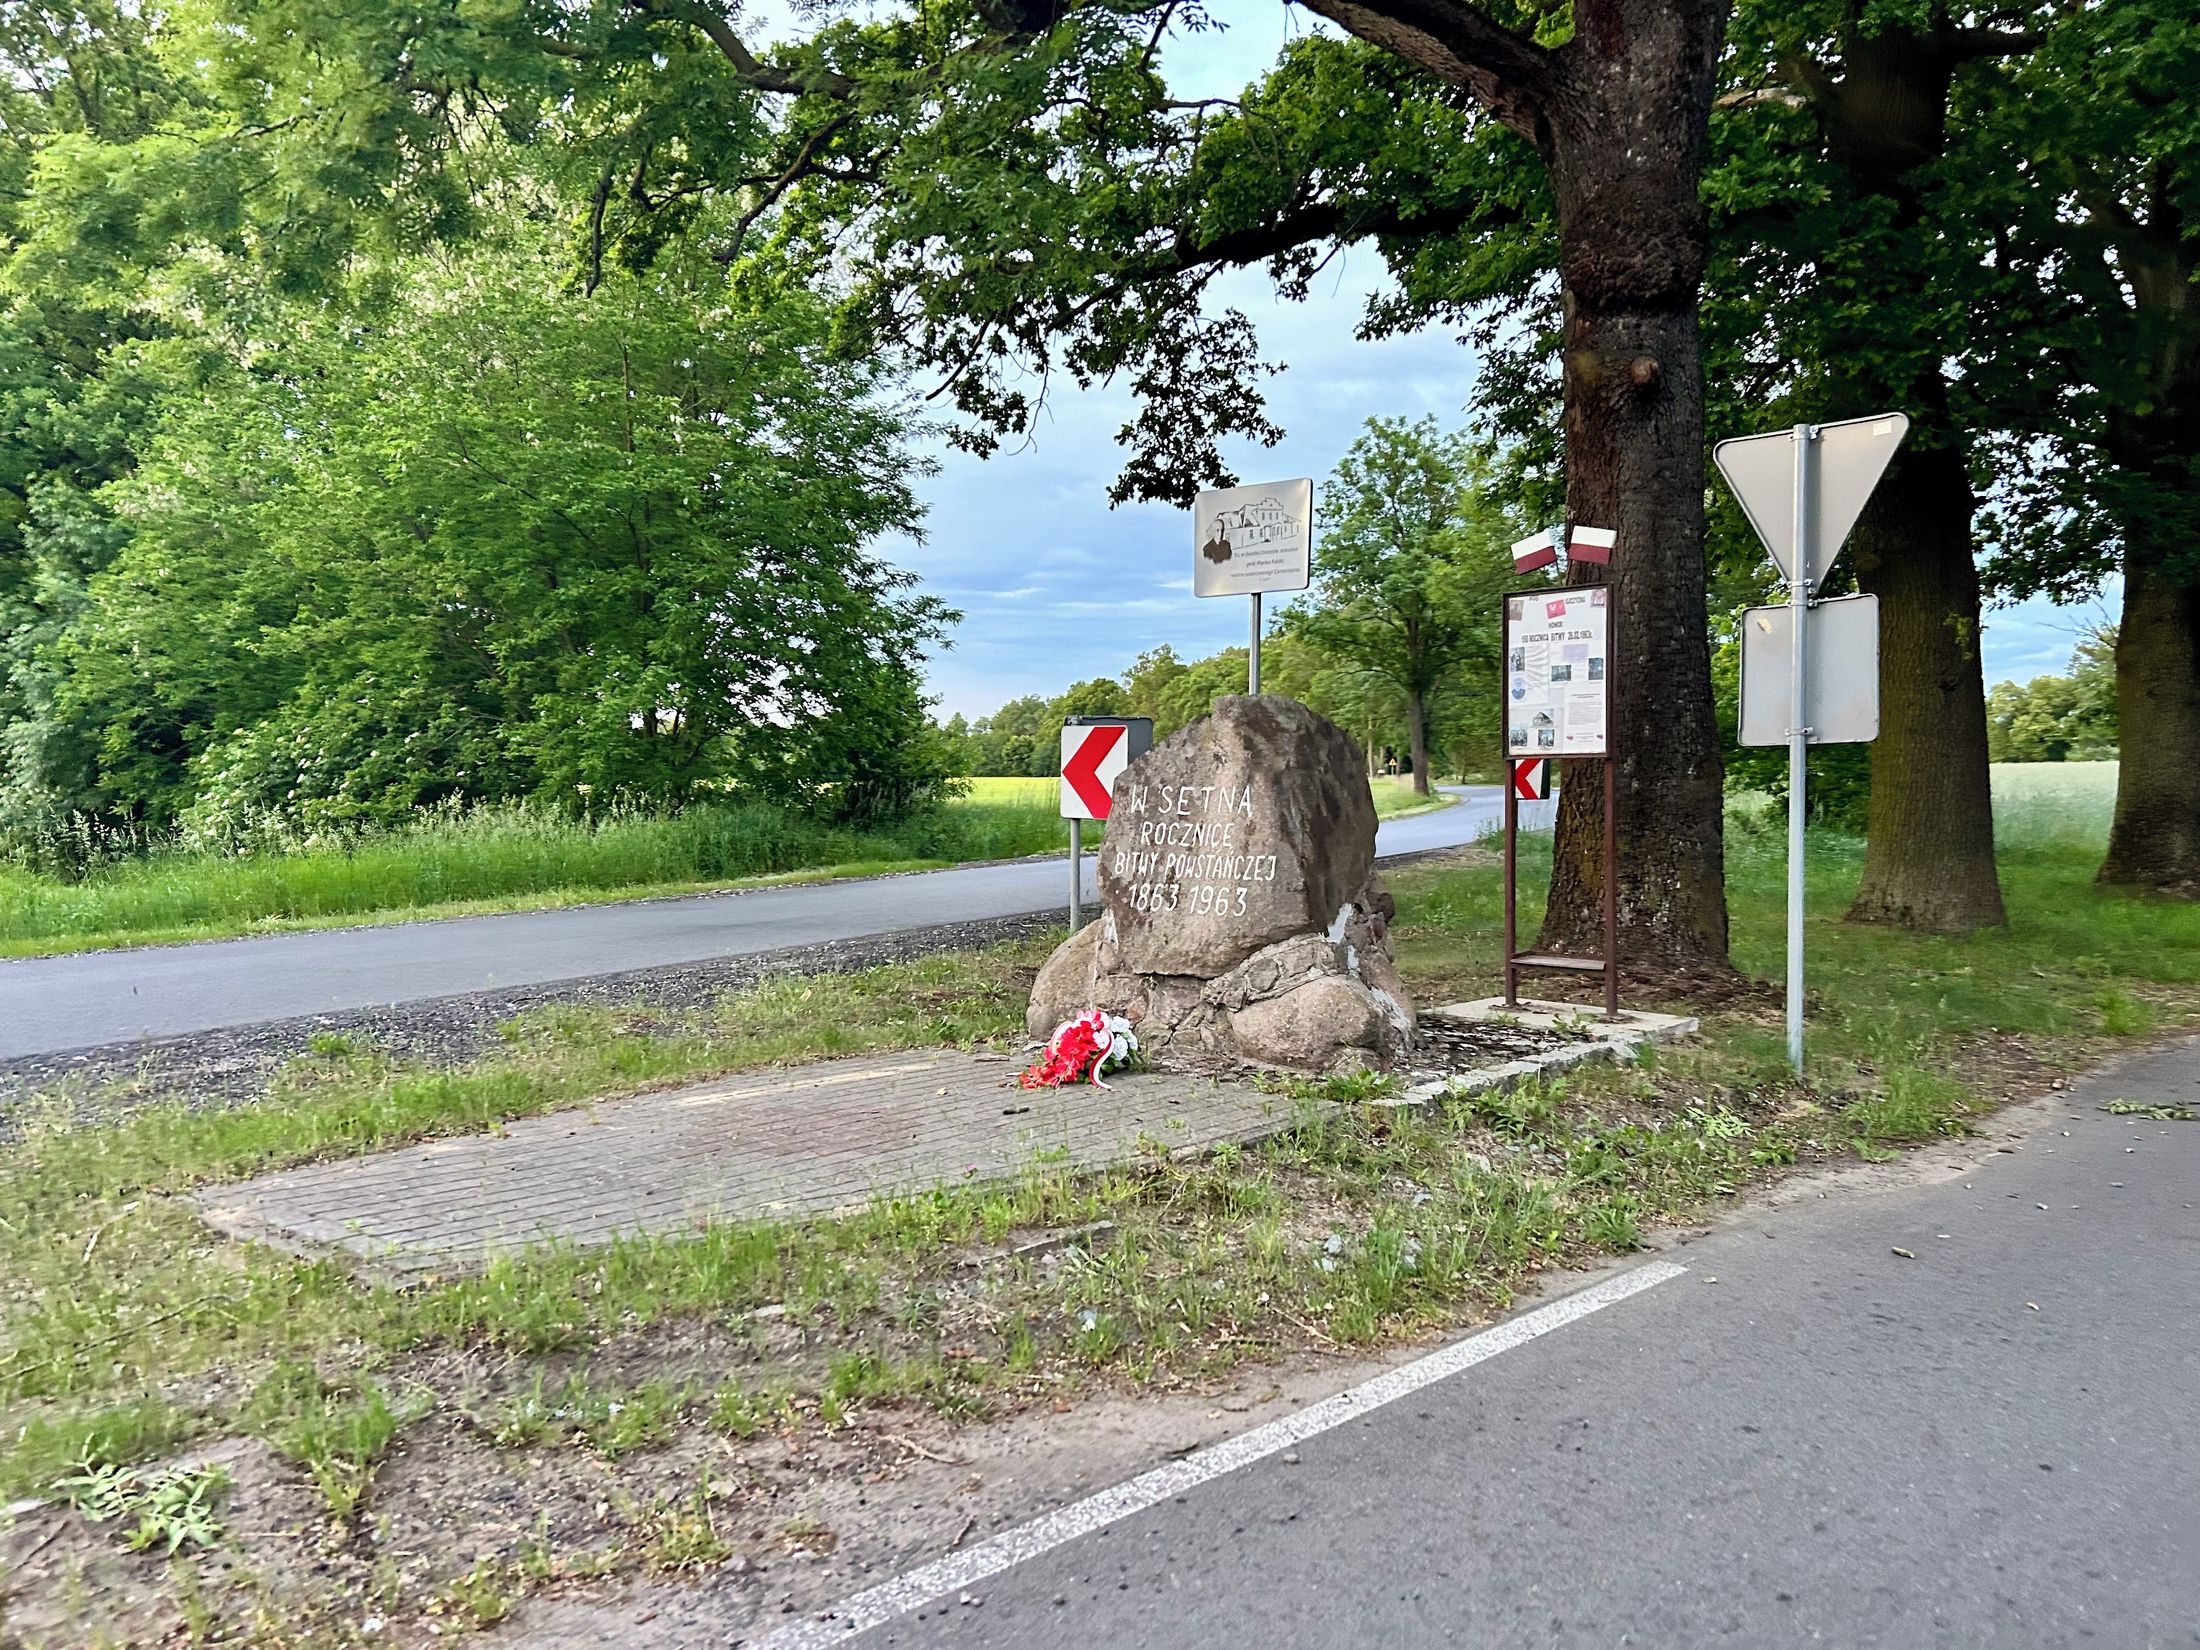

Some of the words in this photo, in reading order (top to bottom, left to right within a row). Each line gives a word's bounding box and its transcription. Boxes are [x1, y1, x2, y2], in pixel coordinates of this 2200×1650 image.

[1529, 633, 1549, 642] ROCZNICA
[1551, 632, 1565, 642] BITWY
[1130, 784, 1148, 815] W
[1158, 784, 1253, 818] SETNĄ
[1140, 821, 1235, 849] ROCZNICĘ
[1114, 851, 1160, 877] BITWY
[1165, 850, 1277, 882] POWSTAŃCZEJ
[1128, 882, 1180, 912] 1863
[1189, 885, 1248, 917] 1963
